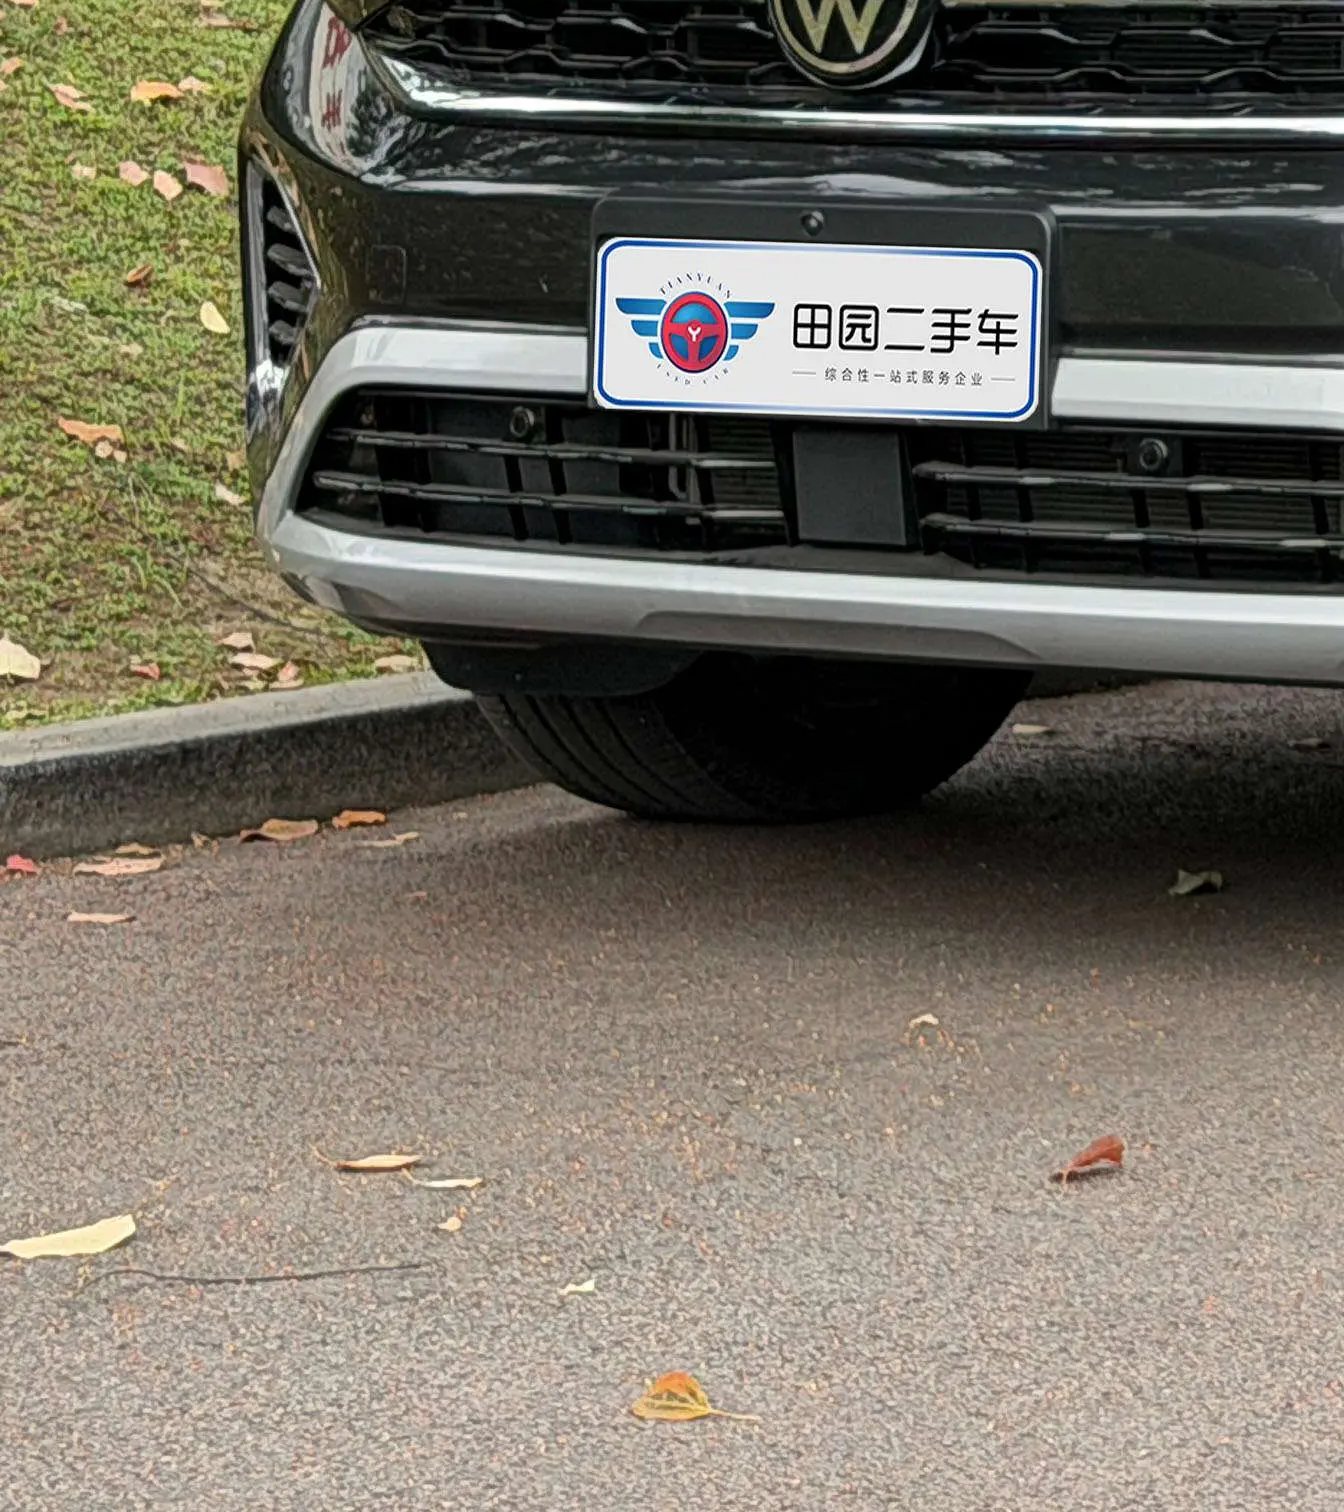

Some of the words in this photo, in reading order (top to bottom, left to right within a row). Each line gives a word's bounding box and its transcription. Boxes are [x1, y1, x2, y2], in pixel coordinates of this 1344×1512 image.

[793, 303, 1019, 356] 田园二手车
[824, 367, 984, 387] 综合性一站式服务企业
